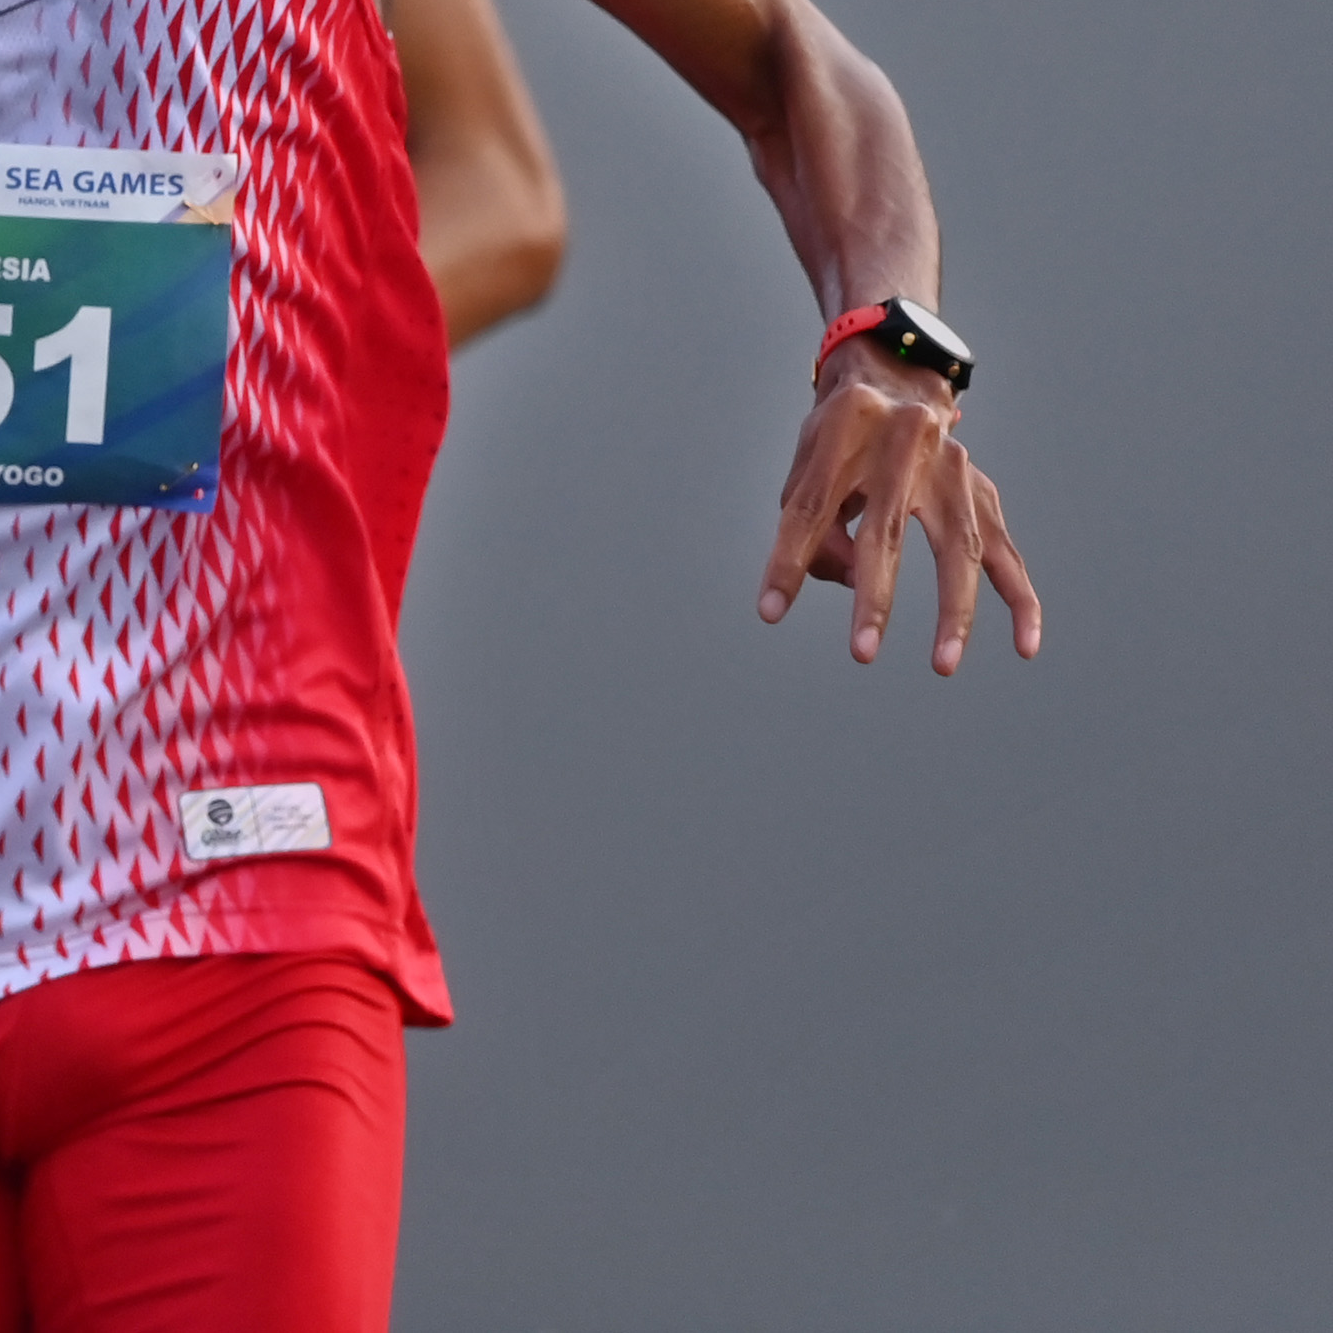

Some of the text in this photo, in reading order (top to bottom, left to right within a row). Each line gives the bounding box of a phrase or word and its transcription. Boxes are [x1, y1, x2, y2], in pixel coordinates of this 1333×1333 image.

[5, 167, 63, 192] SEA
[72, 171, 185, 196] GAMES
[59, 199, 110, 210] VIETNAM
